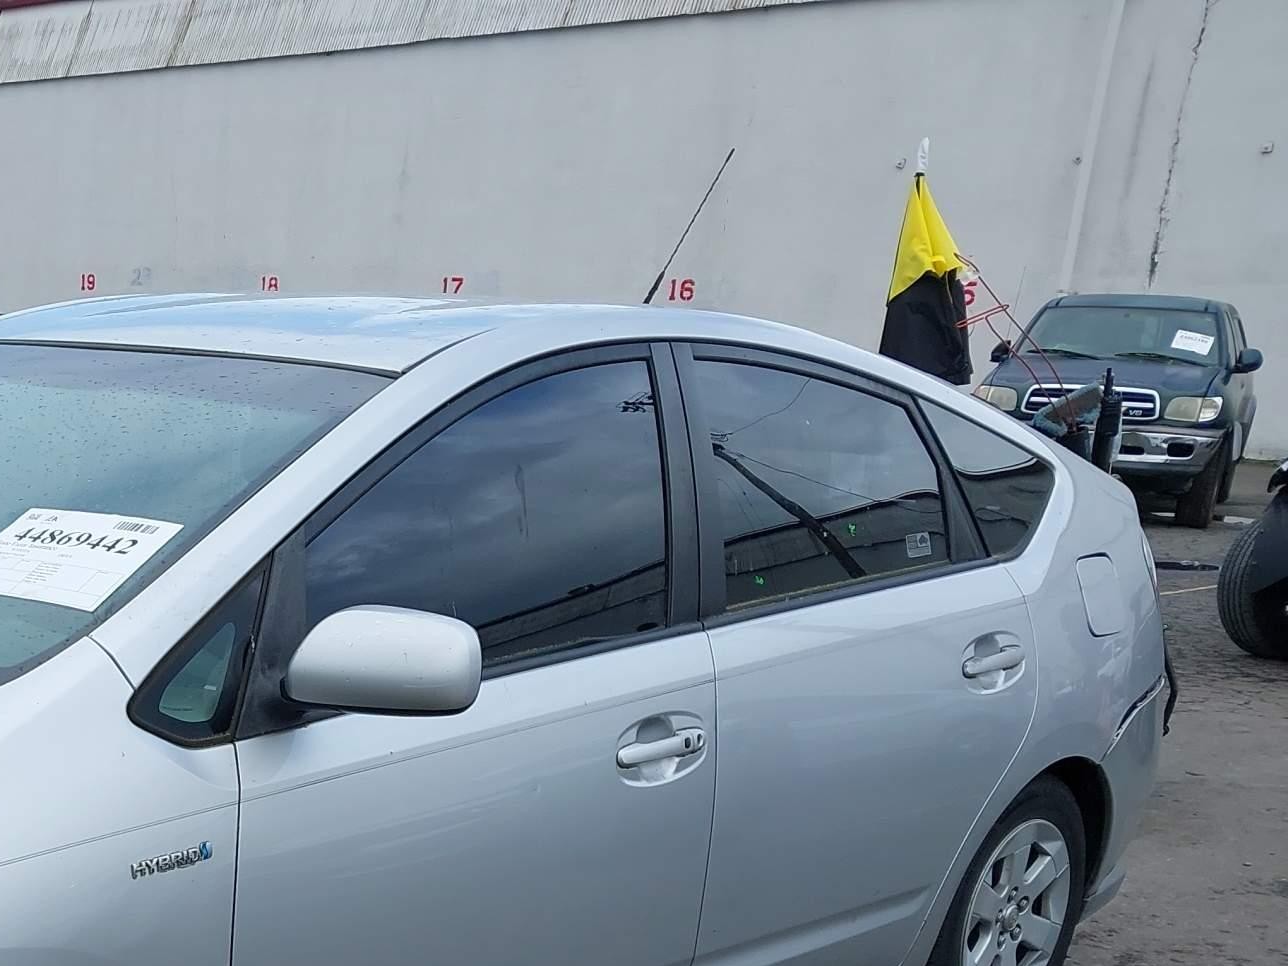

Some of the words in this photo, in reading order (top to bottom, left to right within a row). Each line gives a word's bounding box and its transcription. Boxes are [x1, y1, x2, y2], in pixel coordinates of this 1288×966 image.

[80, 273, 96, 291] 19
[442, 277, 464, 294] 17
[668, 278, 696, 301] 16
[13, 527, 139, 555] 44869442
[130, 847, 202, 880] HYBRID
